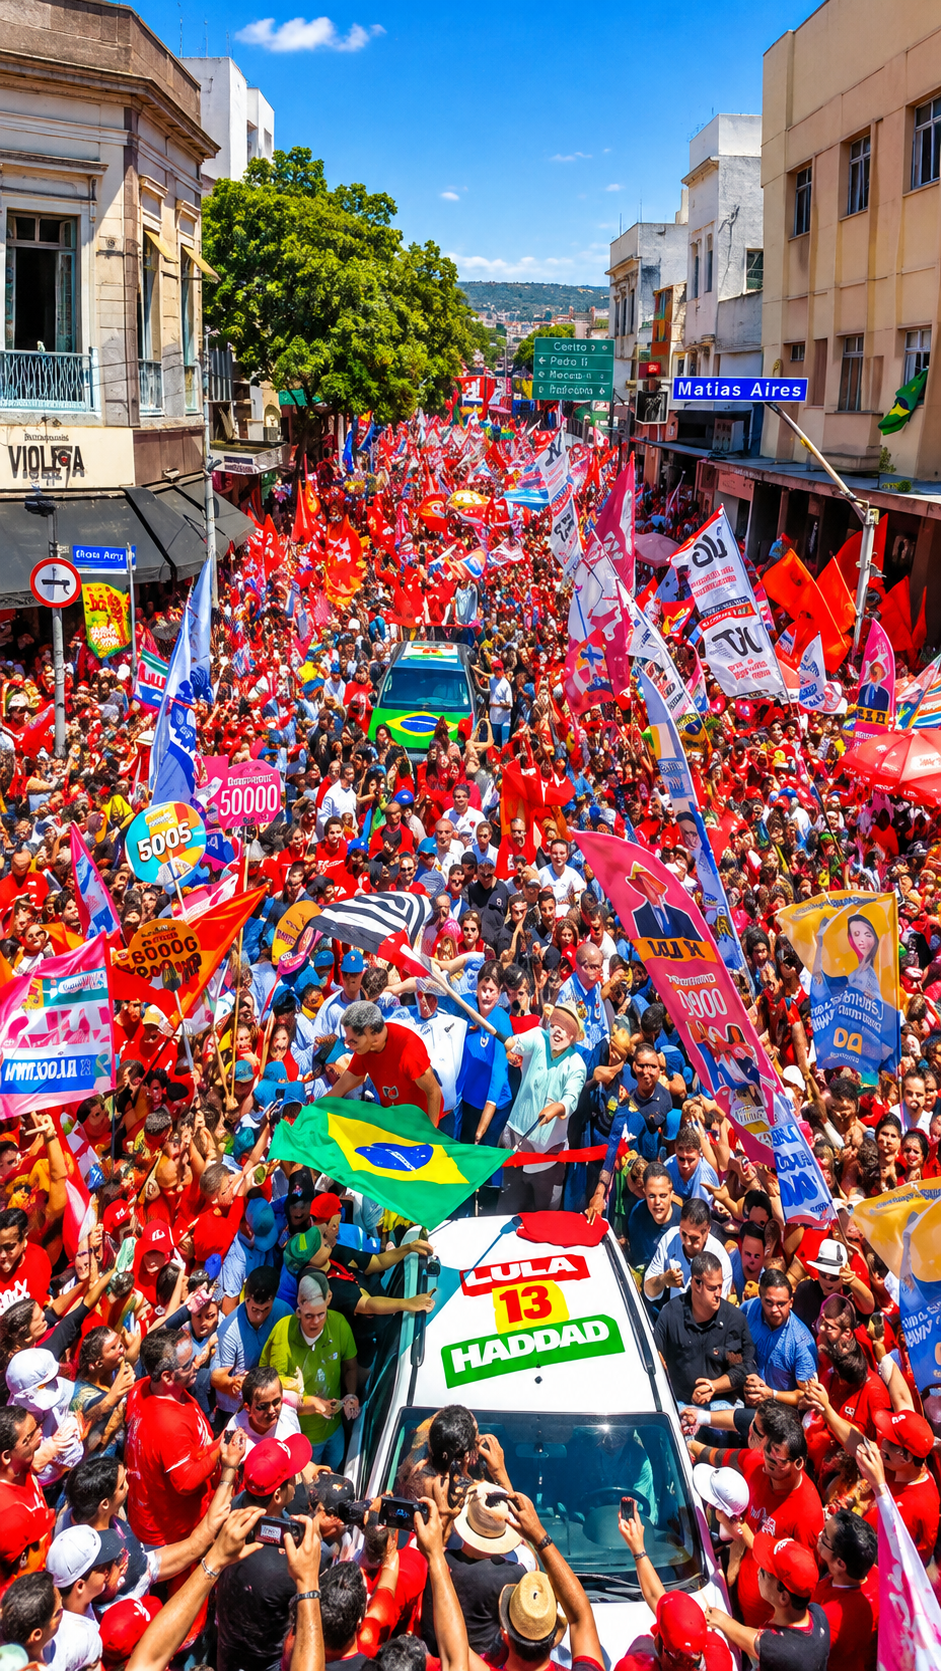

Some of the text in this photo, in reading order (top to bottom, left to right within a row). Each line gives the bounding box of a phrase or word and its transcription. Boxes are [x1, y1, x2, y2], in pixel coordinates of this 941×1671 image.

[678, 381, 802, 397] Matias Aires
[220, 784, 278, 817] 50000
[463, 1256, 578, 1287] LULA
[499, 1285, 553, 1324] 13
[450, 1320, 610, 1374] HADDAD
